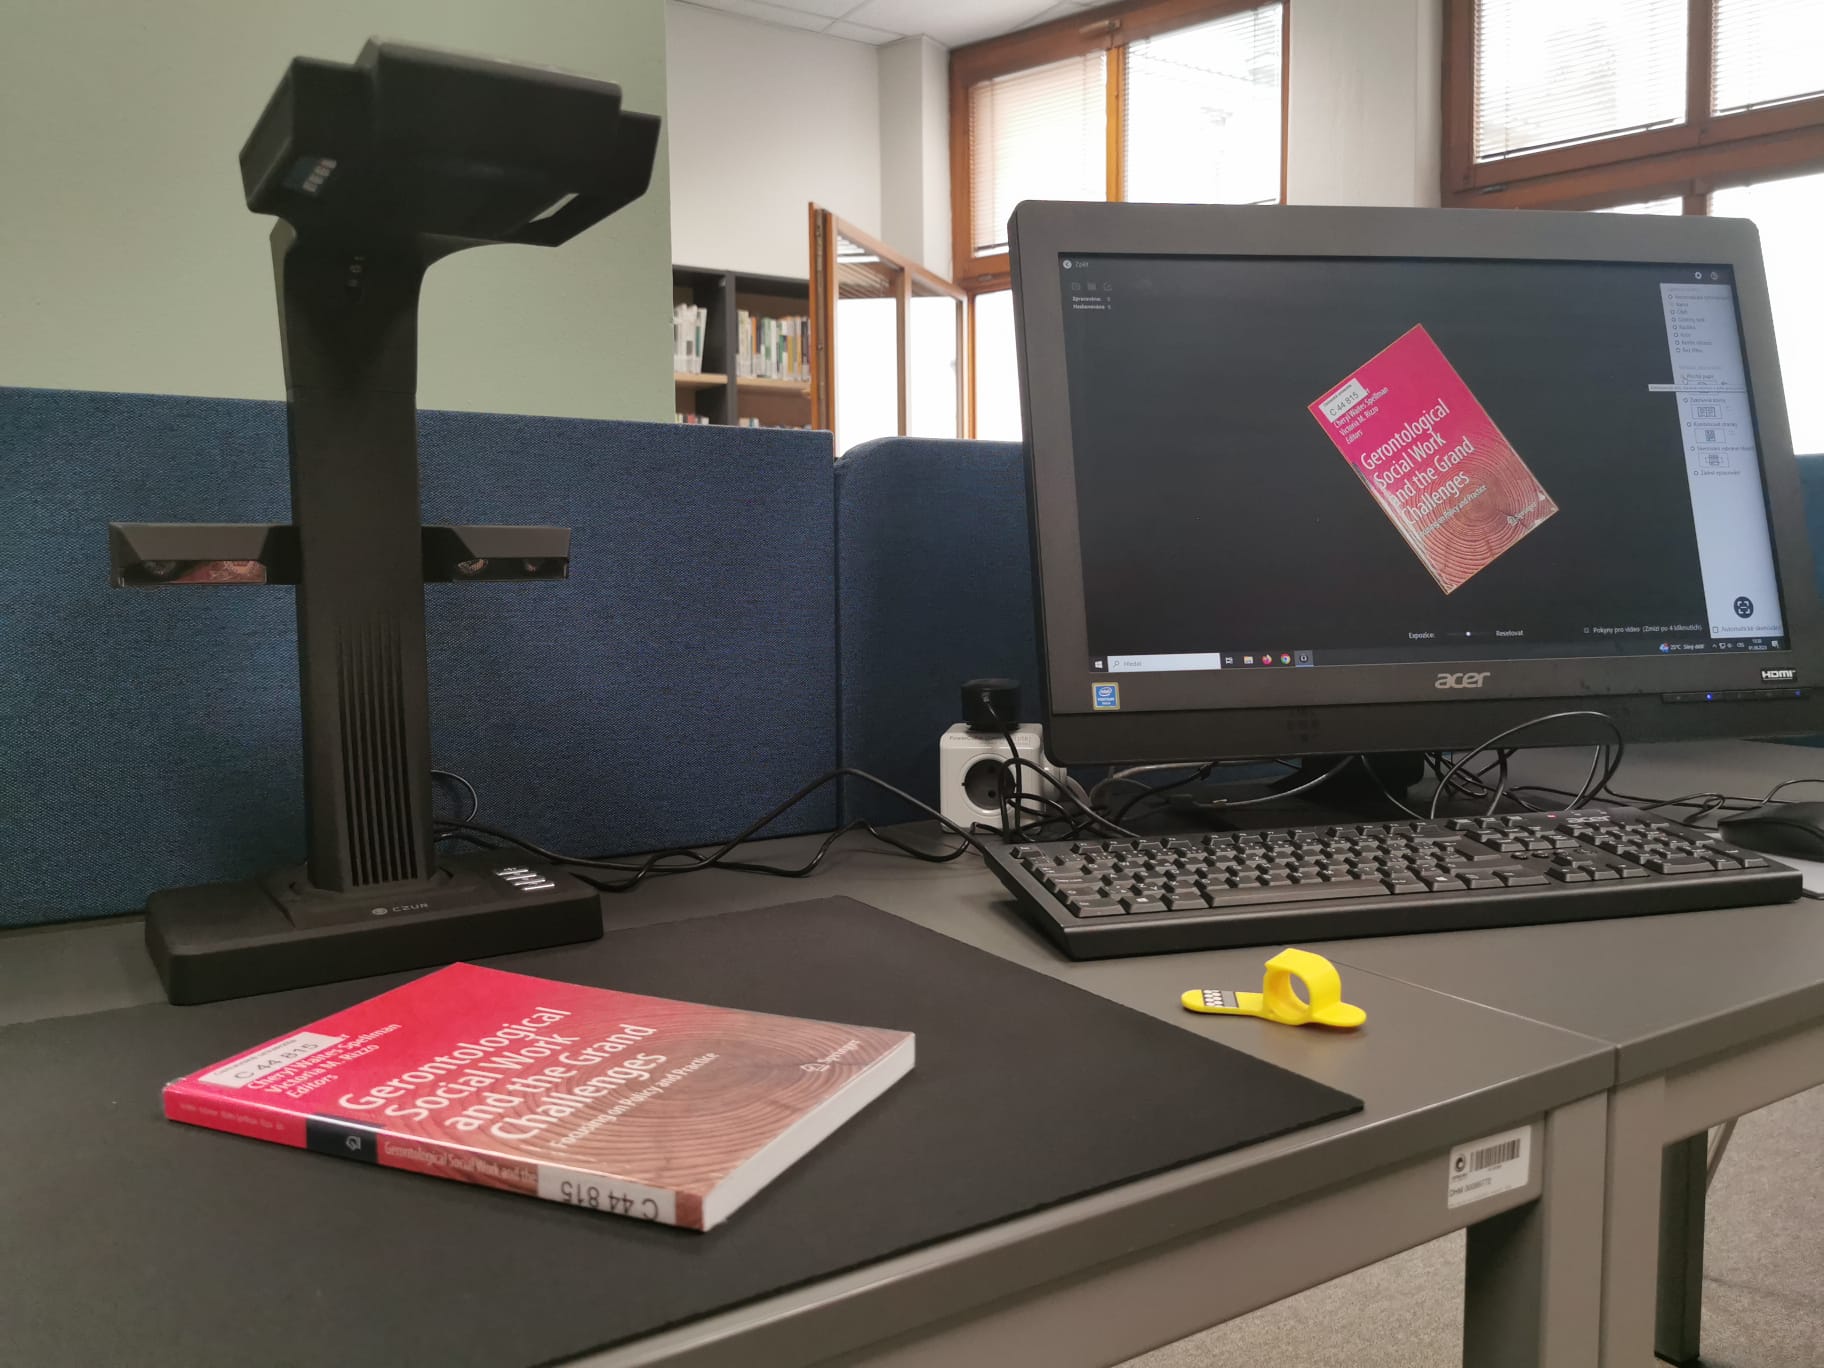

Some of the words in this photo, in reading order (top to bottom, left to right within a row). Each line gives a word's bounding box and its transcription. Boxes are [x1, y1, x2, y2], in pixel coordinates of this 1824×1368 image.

[1329, 408, 1337, 416] C
[1337, 401, 1346, 411] 44
[1345, 391, 1359, 405] 815
[1360, 398, 1450, 470] Gerontological
[1373, 452, 1415, 489] Social
[1408, 431, 1447, 462] Work
[1412, 467, 1438, 489] the
[1434, 435, 1475, 472] Grand
[1400, 471, 1470, 524] Challenges
[1434, 671, 1491, 689] acer
[1761, 669, 1793, 679] HDMI
[392, 903, 428, 912] CZUR
[234, 1070, 255, 1081] C
[256, 1057, 281, 1073] 44
[285, 1042, 320, 1059] 815
[247, 1062, 300, 1090] Cheryl
[292, 1047, 340, 1071] Waites
[338, 1023, 402, 1051] Spellman
[265, 1066, 327, 1093] Victoria
[324, 1057, 346, 1071] M.
[341, 1043, 380, 1061] Rizzo
[339, 1006, 573, 1110] Gerontological
[384, 1069, 505, 1121] Social
[478, 1032, 581, 1070] Work
[444, 1091, 524, 1131] and
[506, 1065, 579, 1092] the
[558, 1023, 658, 1065] Grand
[285, 1073, 339, 1098] Editors
[490, 1052, 667, 1140] Challenges
[551, 1114, 618, 1149] Focusing
[608, 1103, 630, 1117] on
[624, 1085, 664, 1107] Policy
[656, 1073, 683, 1089] and
[671, 1052, 720, 1076] Practice
[561, 1180, 600, 1209] 815
[608, 1189, 634, 1214] 44
[642, 1198, 659, 1220] C
